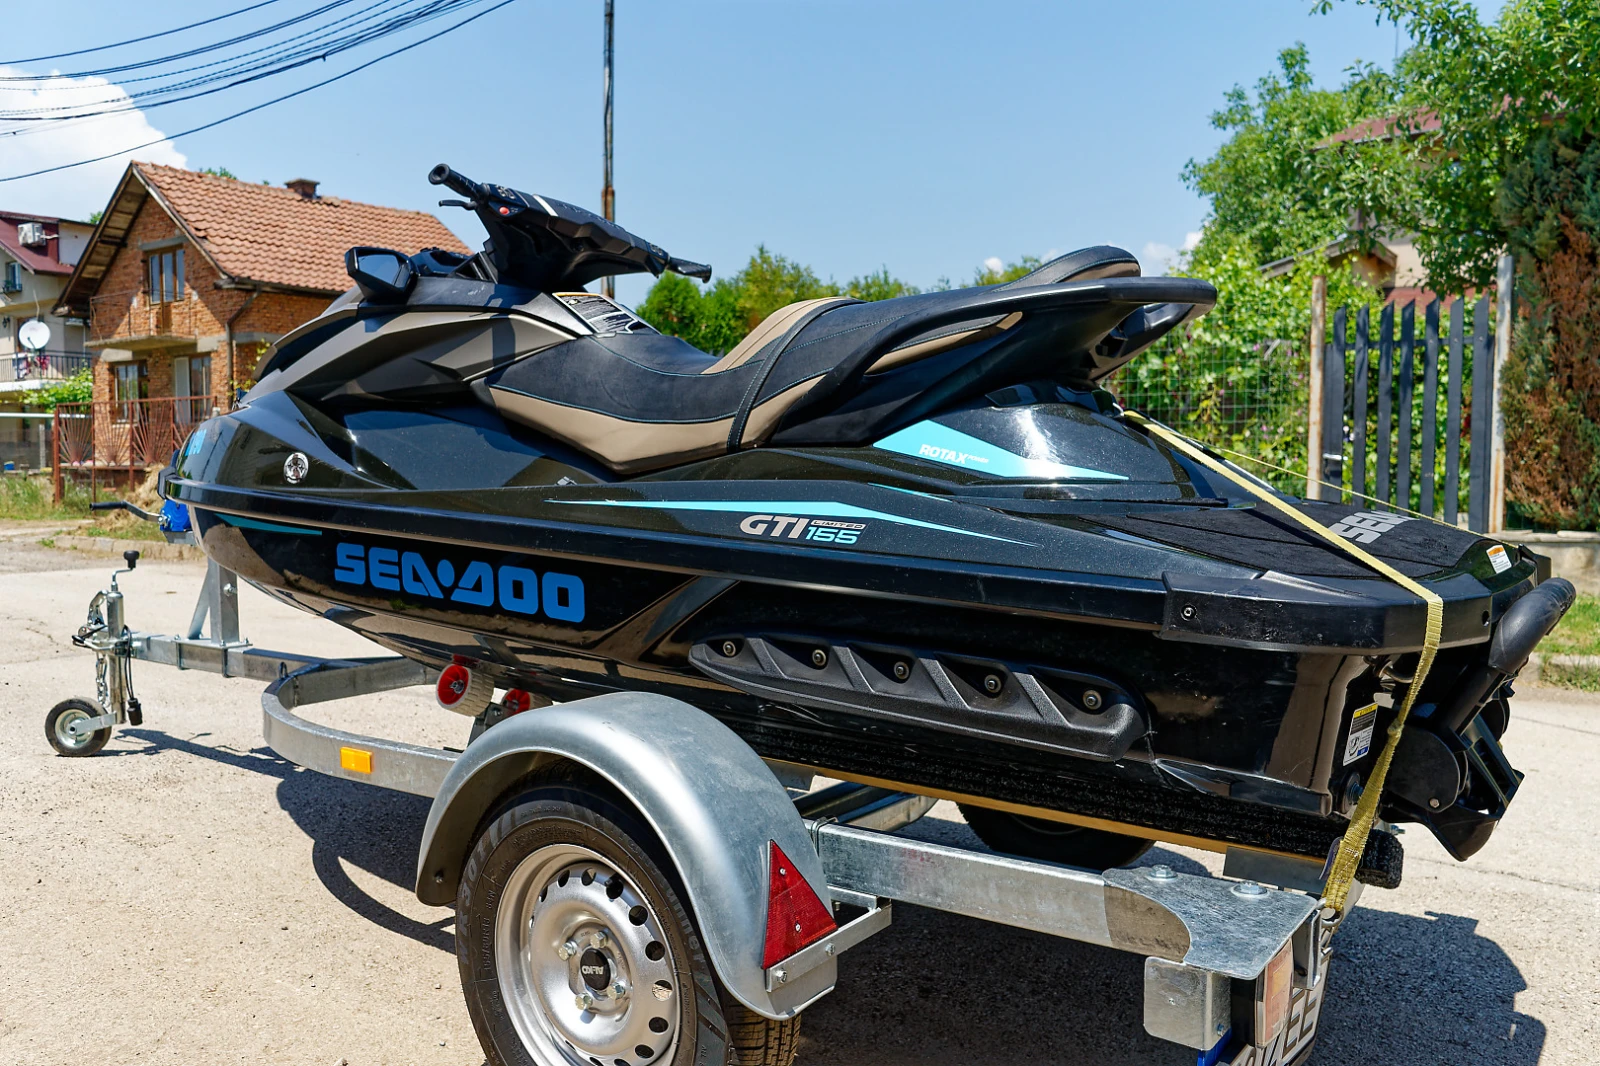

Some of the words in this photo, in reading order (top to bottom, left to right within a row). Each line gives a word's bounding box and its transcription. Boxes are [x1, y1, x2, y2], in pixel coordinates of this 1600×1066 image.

[919, 444, 968, 464] ROTAX
[740, 515, 810, 539] GTI
[811, 520, 866, 530] LIMITED
[805, 526, 861, 545] 155
